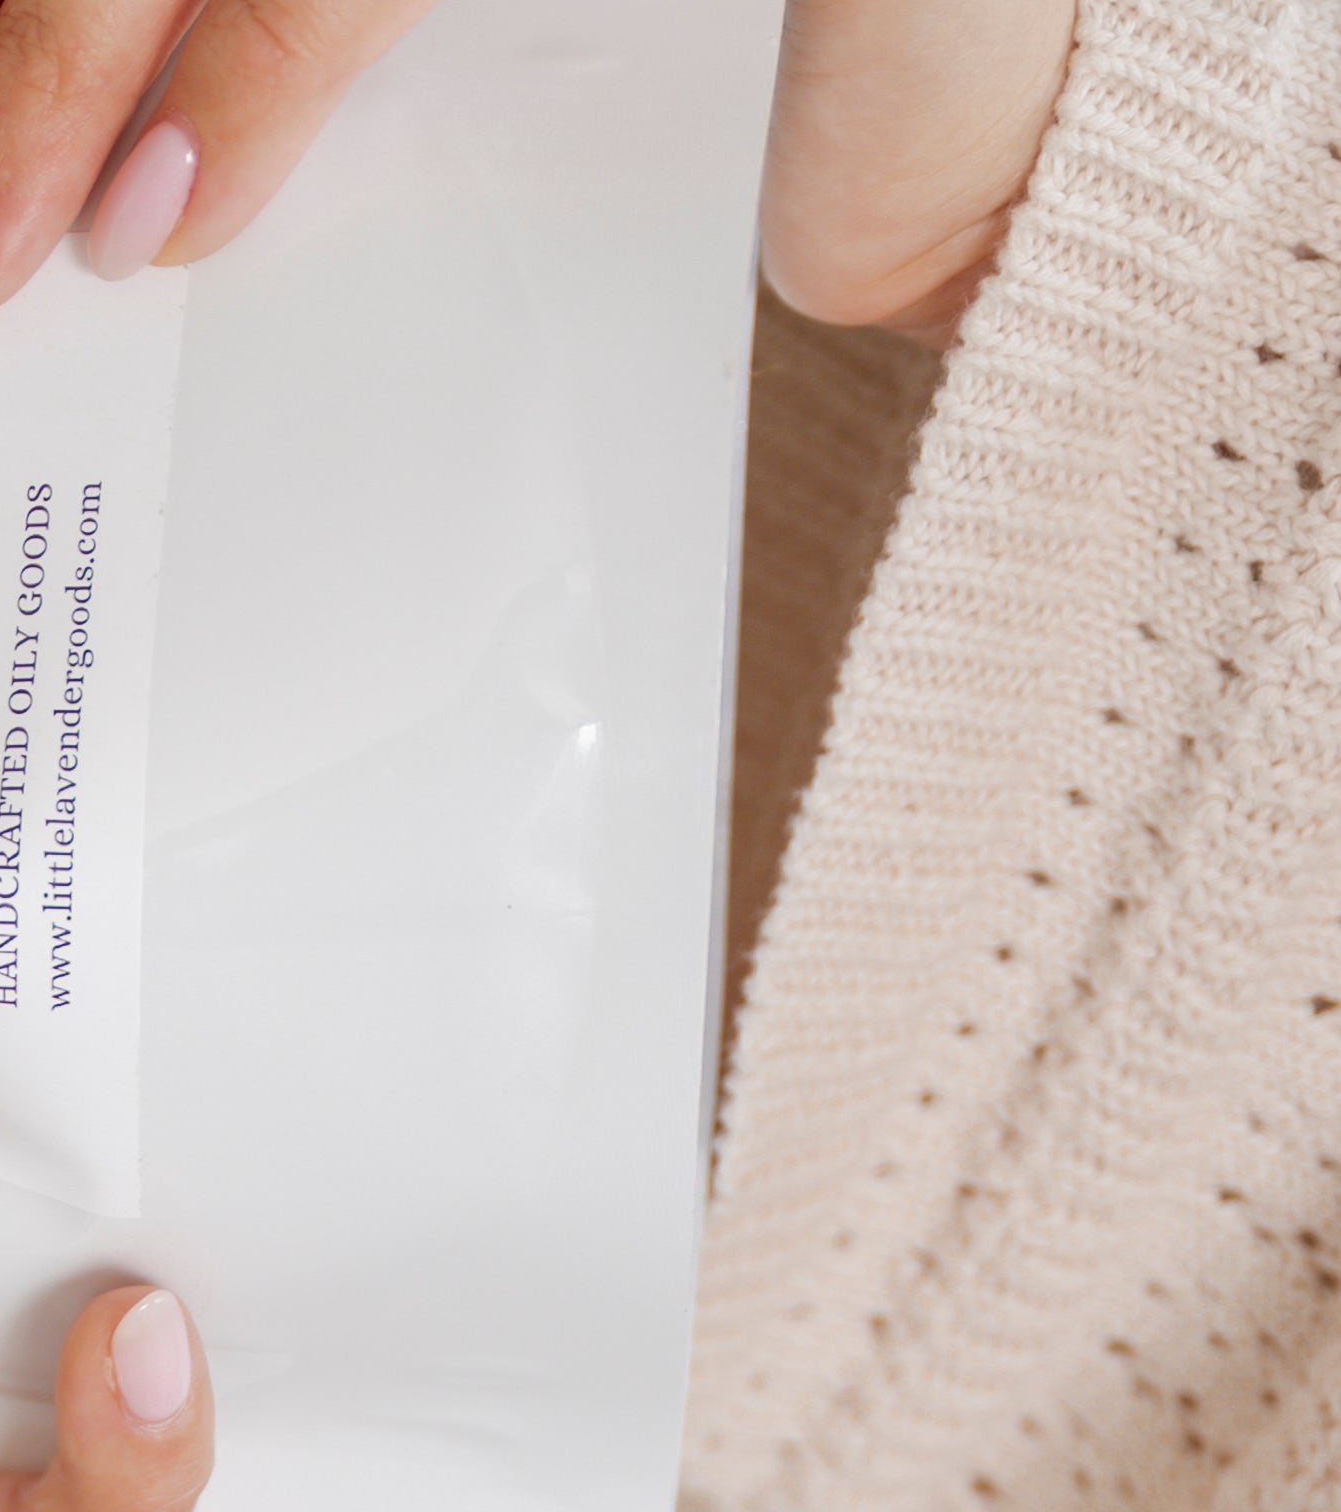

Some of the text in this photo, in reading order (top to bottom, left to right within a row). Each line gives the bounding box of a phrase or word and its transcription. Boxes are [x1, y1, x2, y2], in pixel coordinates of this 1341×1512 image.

[16, 482, 54, 617] GOODS
[7, 625, 40, 716] OILY
[42, 480, 103, 1012] www.littlelavendergoods.com
